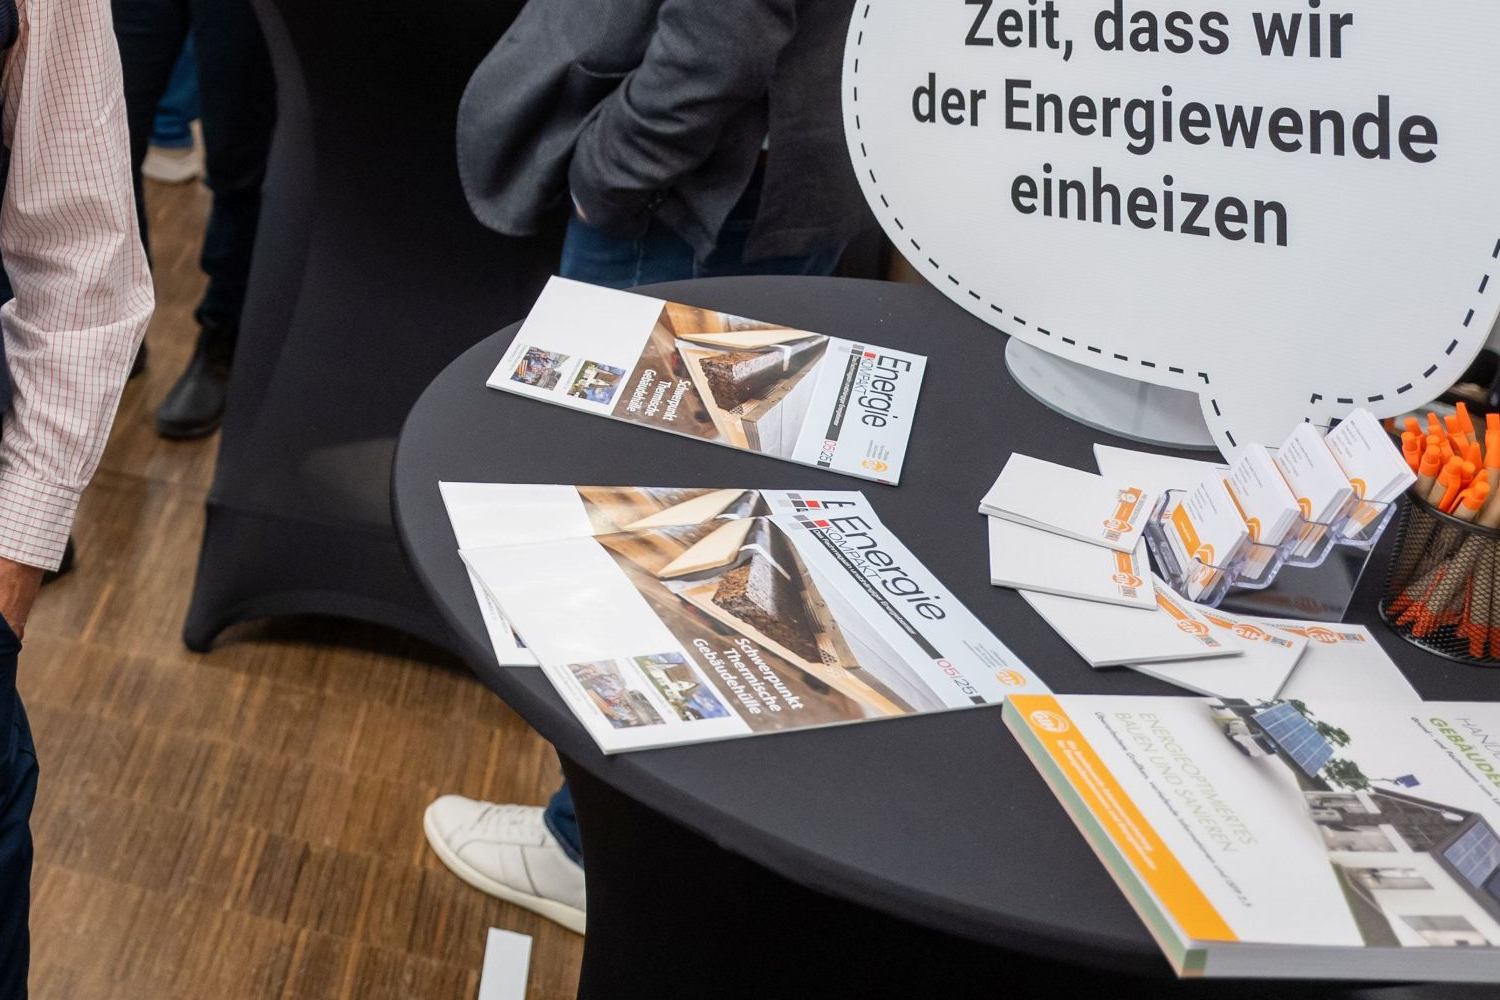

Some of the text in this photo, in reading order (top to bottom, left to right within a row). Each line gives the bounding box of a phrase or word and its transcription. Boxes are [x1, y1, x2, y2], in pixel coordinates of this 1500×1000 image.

[911, 72, 1438, 164] der Energiewende
[1010, 163, 1288, 247] einheizen
[626, 369, 657, 412] Gebäudehülle
[644, 380, 672, 416] Thermische
[662, 379, 692, 421] Schwerpunkt
[854, 358, 875, 396] KOMPAKT
[858, 355, 911, 428] Energie
[823, 527, 881, 580] KOMPAKT
[828, 515, 946, 620] Energie
[692, 638, 762, 715] Gebäudehülle
[723, 647, 782, 712] Thermische
[734, 638, 804, 710] Schwerpunkt
[1114, 711, 1239, 853] BAUEN UND SANIEREN
